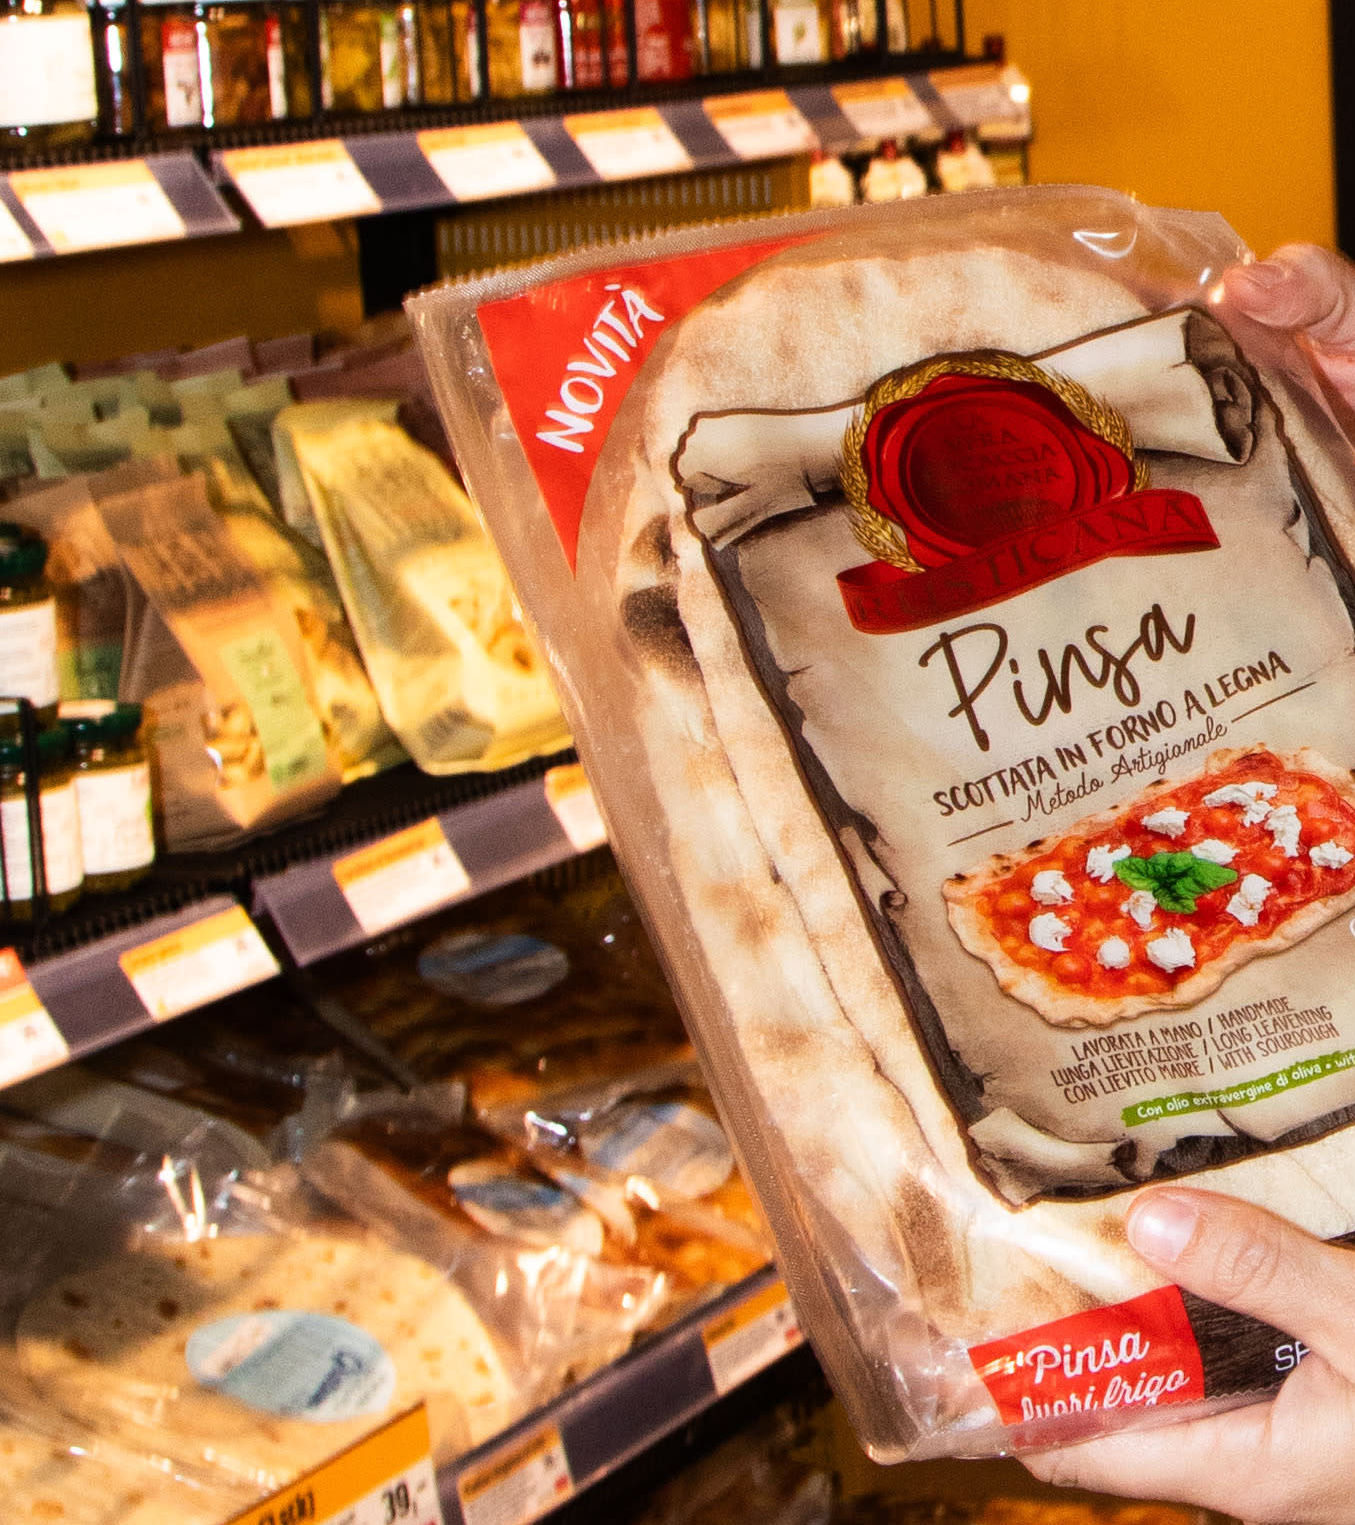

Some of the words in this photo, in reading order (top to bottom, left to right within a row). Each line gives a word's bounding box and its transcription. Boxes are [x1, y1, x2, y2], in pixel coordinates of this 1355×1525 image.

[534, 283, 666, 453] NOVITÀ
[917, 603, 1196, 752] Pinsa
[933, 754, 1057, 817] SCOTTATA
[1056, 743, 1089, 773] IN
[1086, 699, 1177, 759] FORNO
[1183, 689, 1208, 721] A
[1203, 651, 1293, 709] LEGNA
[1021, 777, 1105, 822] Metodo
[1110, 715, 1229, 786] Artigianale
[1050, 1059, 1103, 1087] LUNGA
[1101, 1042, 1199, 1073] LIEVITAZIONE
[1211, 1026, 1253, 1053] LONG
[1252, 1005, 1333, 1039] LEAVENING
[1063, 1080, 1099, 1105] CON
[1099, 1066, 1157, 1095] LIEVITO
[1157, 1060, 1206, 1081] MADRE
[1217, 1046, 1257, 1071] WITH
[1256, 1022, 1341, 1058] SOURDOUGH
[1070, 1031, 1147, 1062] LAVORATA
[1148, 1029, 1159, 1046] A
[1159, 1021, 1203, 1044] MANO
[1216, 996, 1295, 1031] HANDMADE
[1136, 1103, 1164, 1119] Con
[1166, 1095, 1190, 1112] olio
[1192, 1081, 1273, 1107] extravergine
[1275, 1073, 1290, 1088] di
[1291, 1062, 1322, 1081] oliva
[1025, 1332, 1151, 1384] Pinsa
